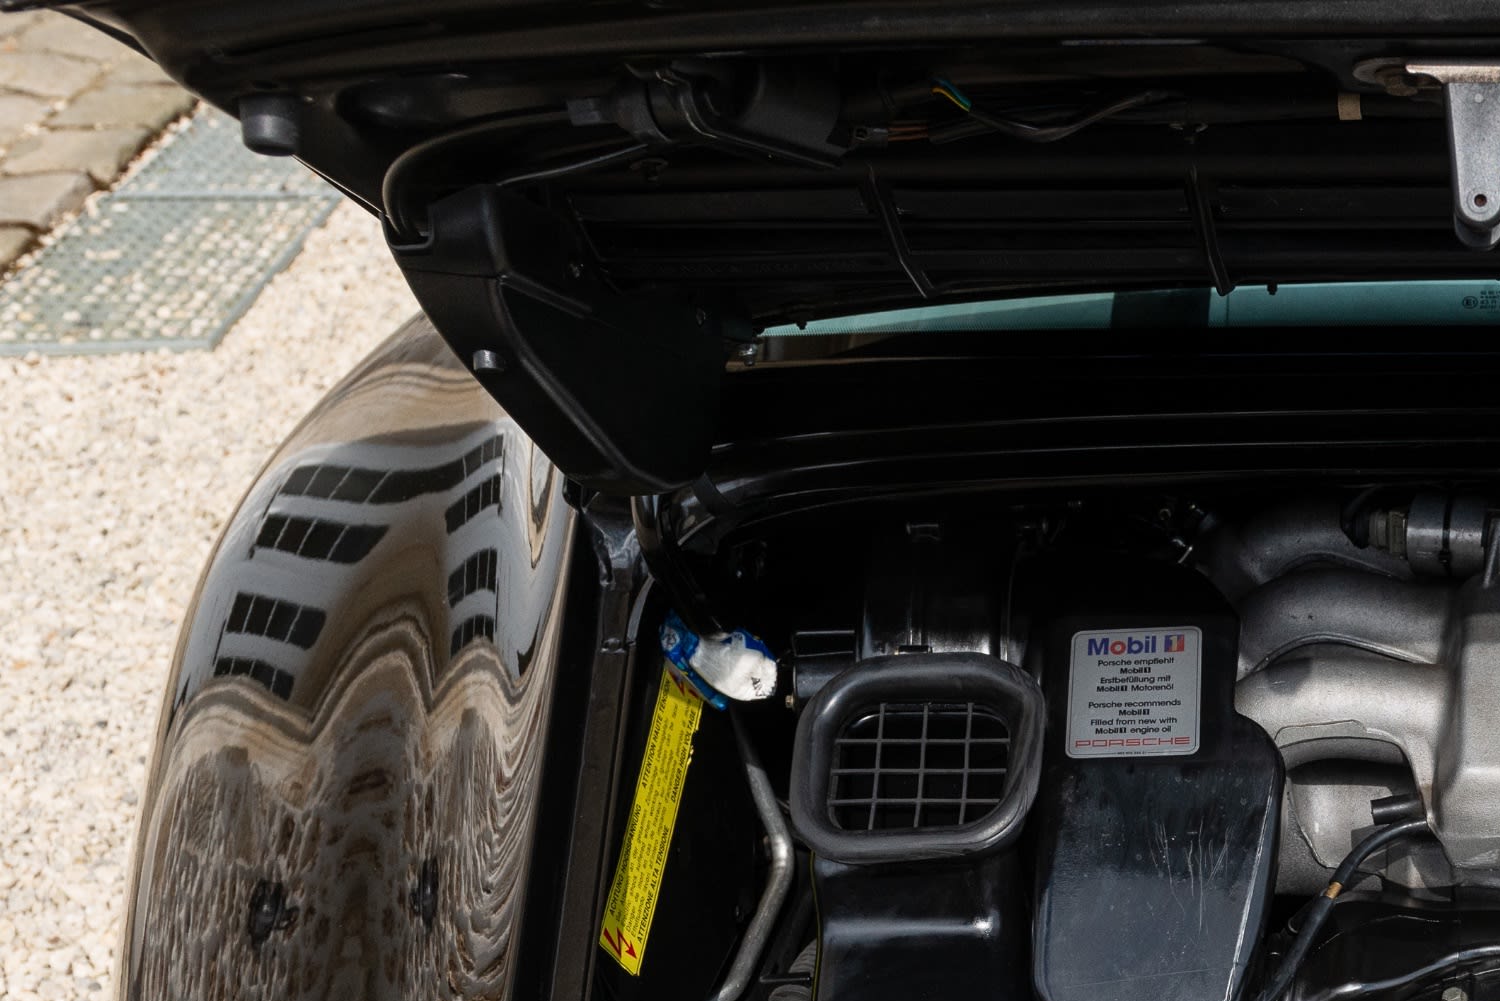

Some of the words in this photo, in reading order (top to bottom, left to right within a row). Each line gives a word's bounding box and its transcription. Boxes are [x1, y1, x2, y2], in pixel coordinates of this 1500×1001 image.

[1088, 635, 1156, 655] Mobil
[1134, 658, 1174, 666] empfiehlt
[1100, 676, 1155, 684] Erstbefüllung
[1088, 701, 1122, 709] Porsche
[1124, 699, 1181, 707] recommends
[641, 742, 656, 788] ATTENTION
[651, 713, 663, 741] HAUTE
[1075, 736, 1190, 748] PORSCHE
[670, 768, 682, 802] DANGER
[678, 746, 687, 767] HIGH
[683, 709, 696, 744] VOLTAGE
[636, 889, 653, 943] ATTENZIONE
[649, 867, 659, 889] ALTA
[654, 824, 669, 865] TENSIONE
[609, 872, 623, 917] ACHTUNG
